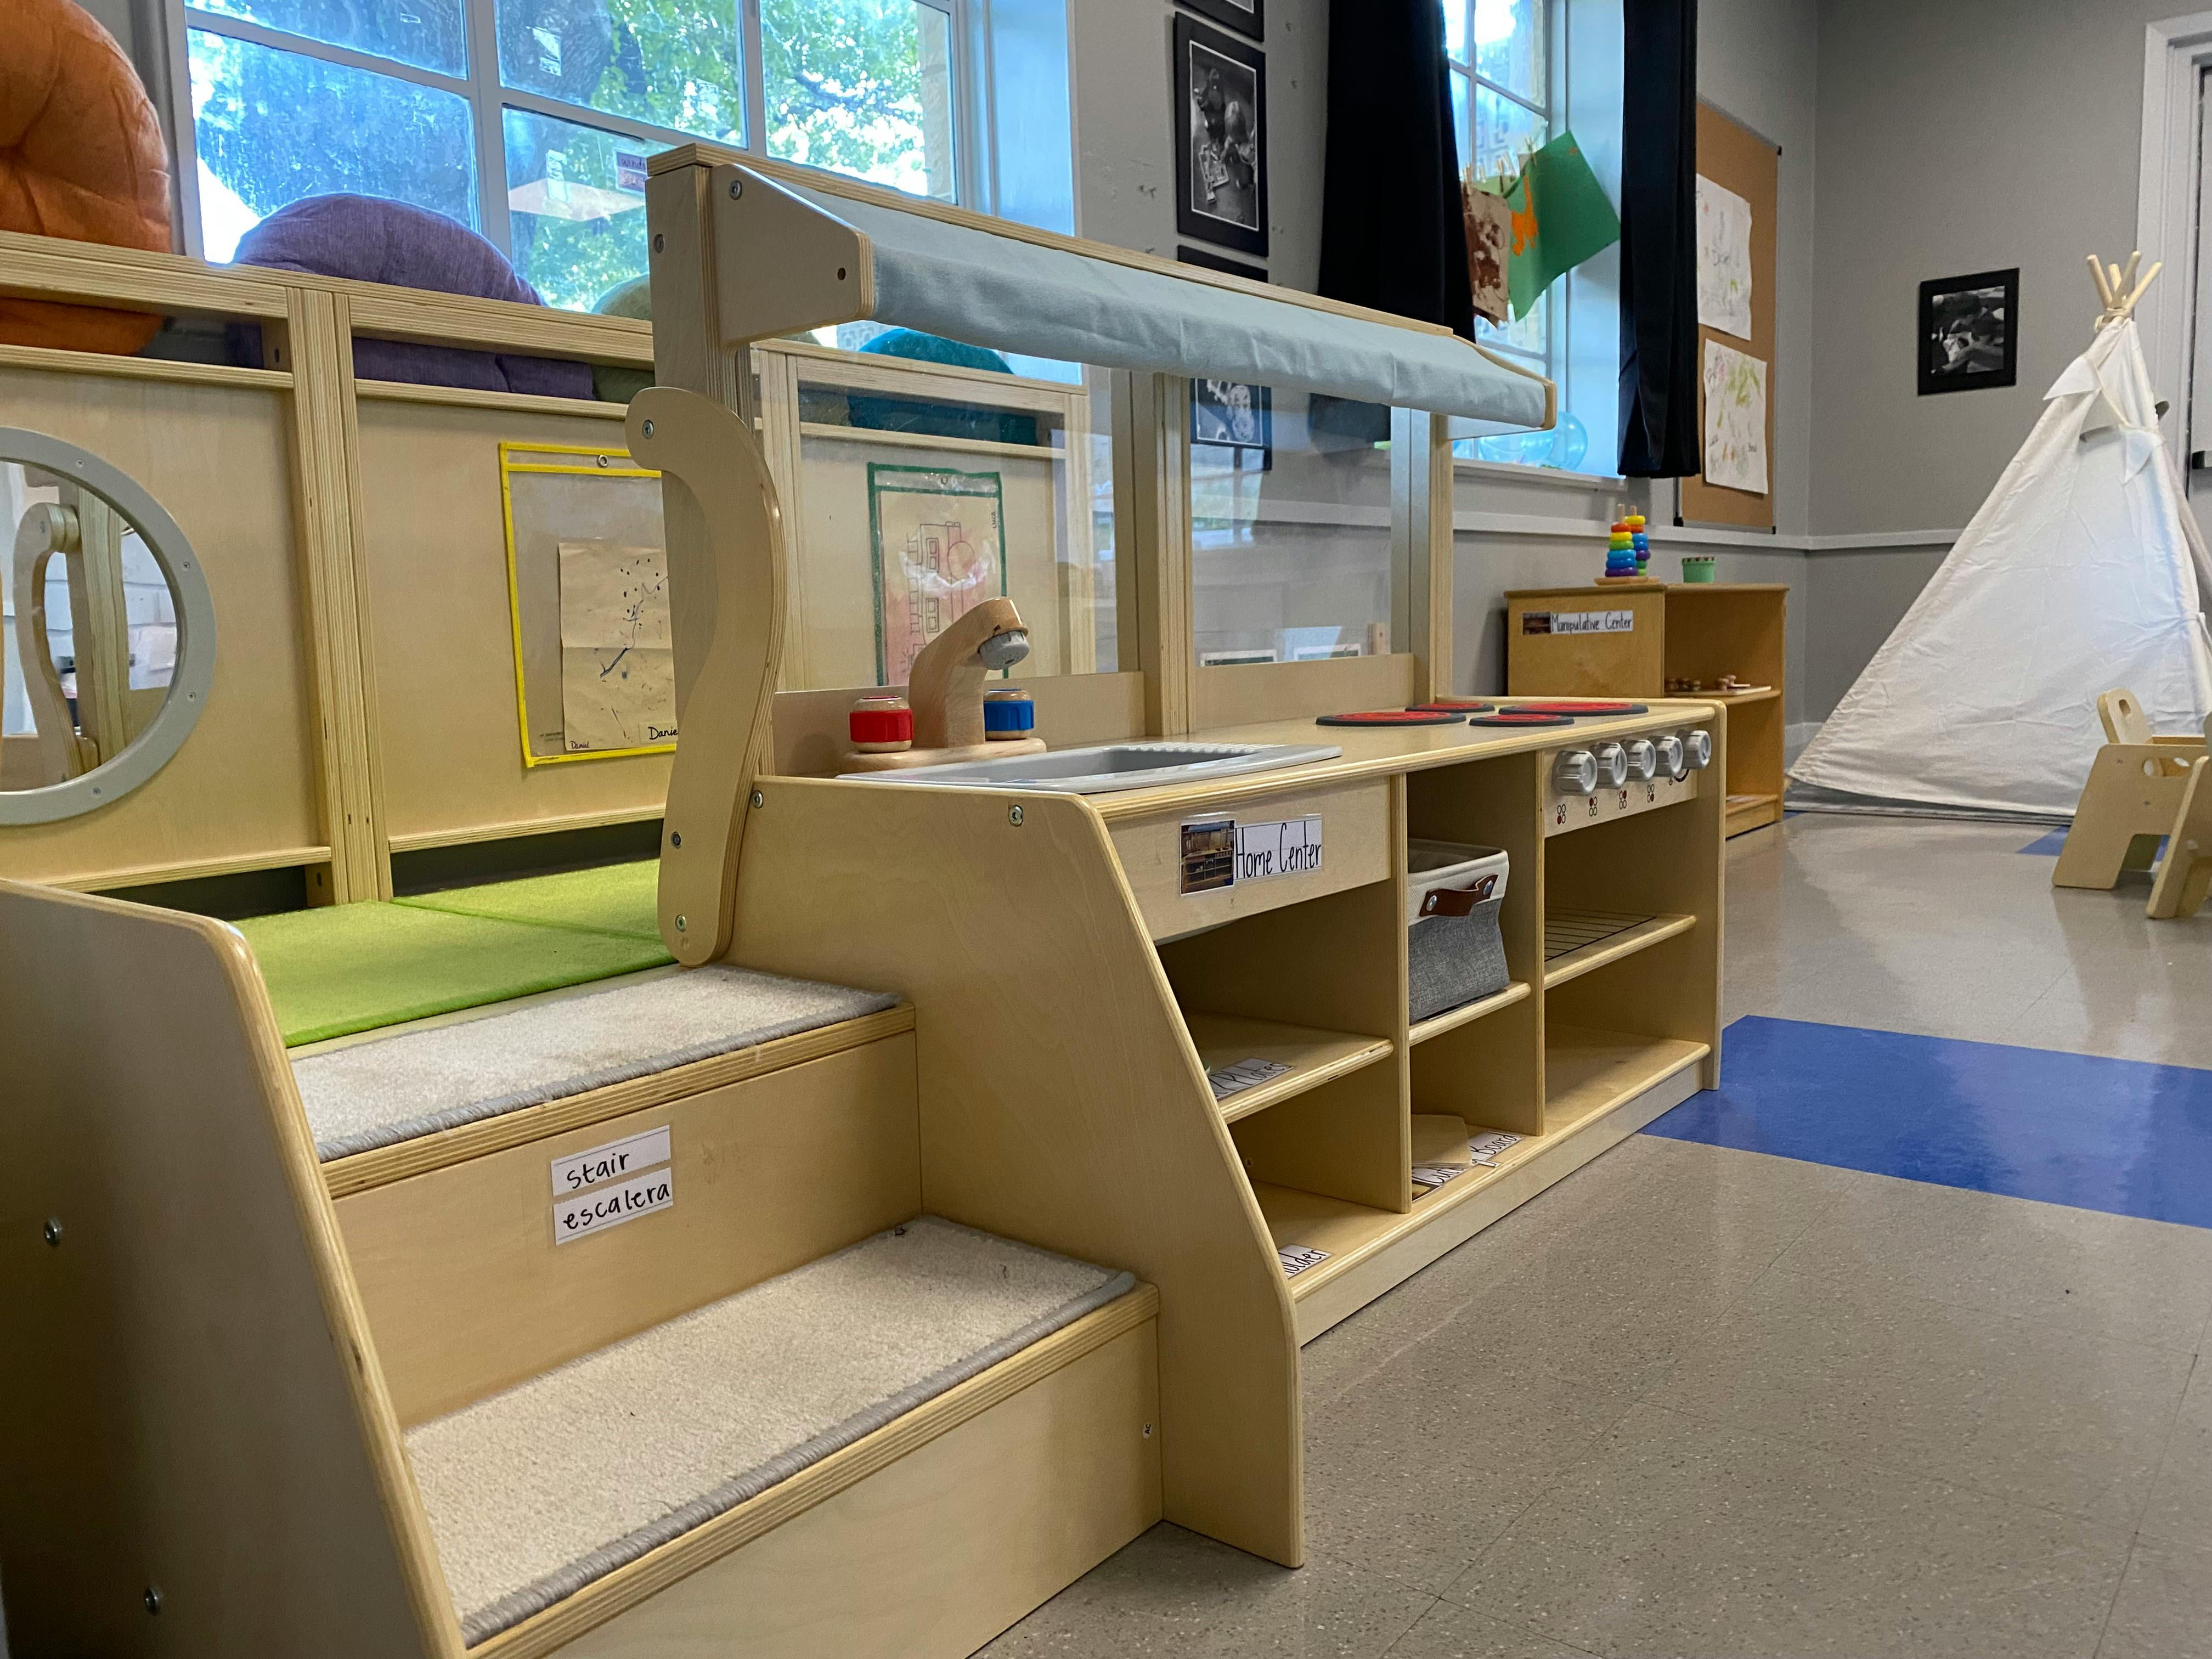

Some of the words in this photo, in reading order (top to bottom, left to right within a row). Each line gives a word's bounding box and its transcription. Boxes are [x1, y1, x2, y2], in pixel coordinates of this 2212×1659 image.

[1551, 613, 1600, 634] Manipulative
[1605, 612, 1632, 630] Center
[647, 726, 678, 740] Danie
[1235, 827, 1273, 878] Home
[1279, 821, 1322, 872] Center
[567, 1153, 630, 1189] stair
[563, 1183, 670, 1229] escalera
[1278, 1250, 1327, 1274] older
